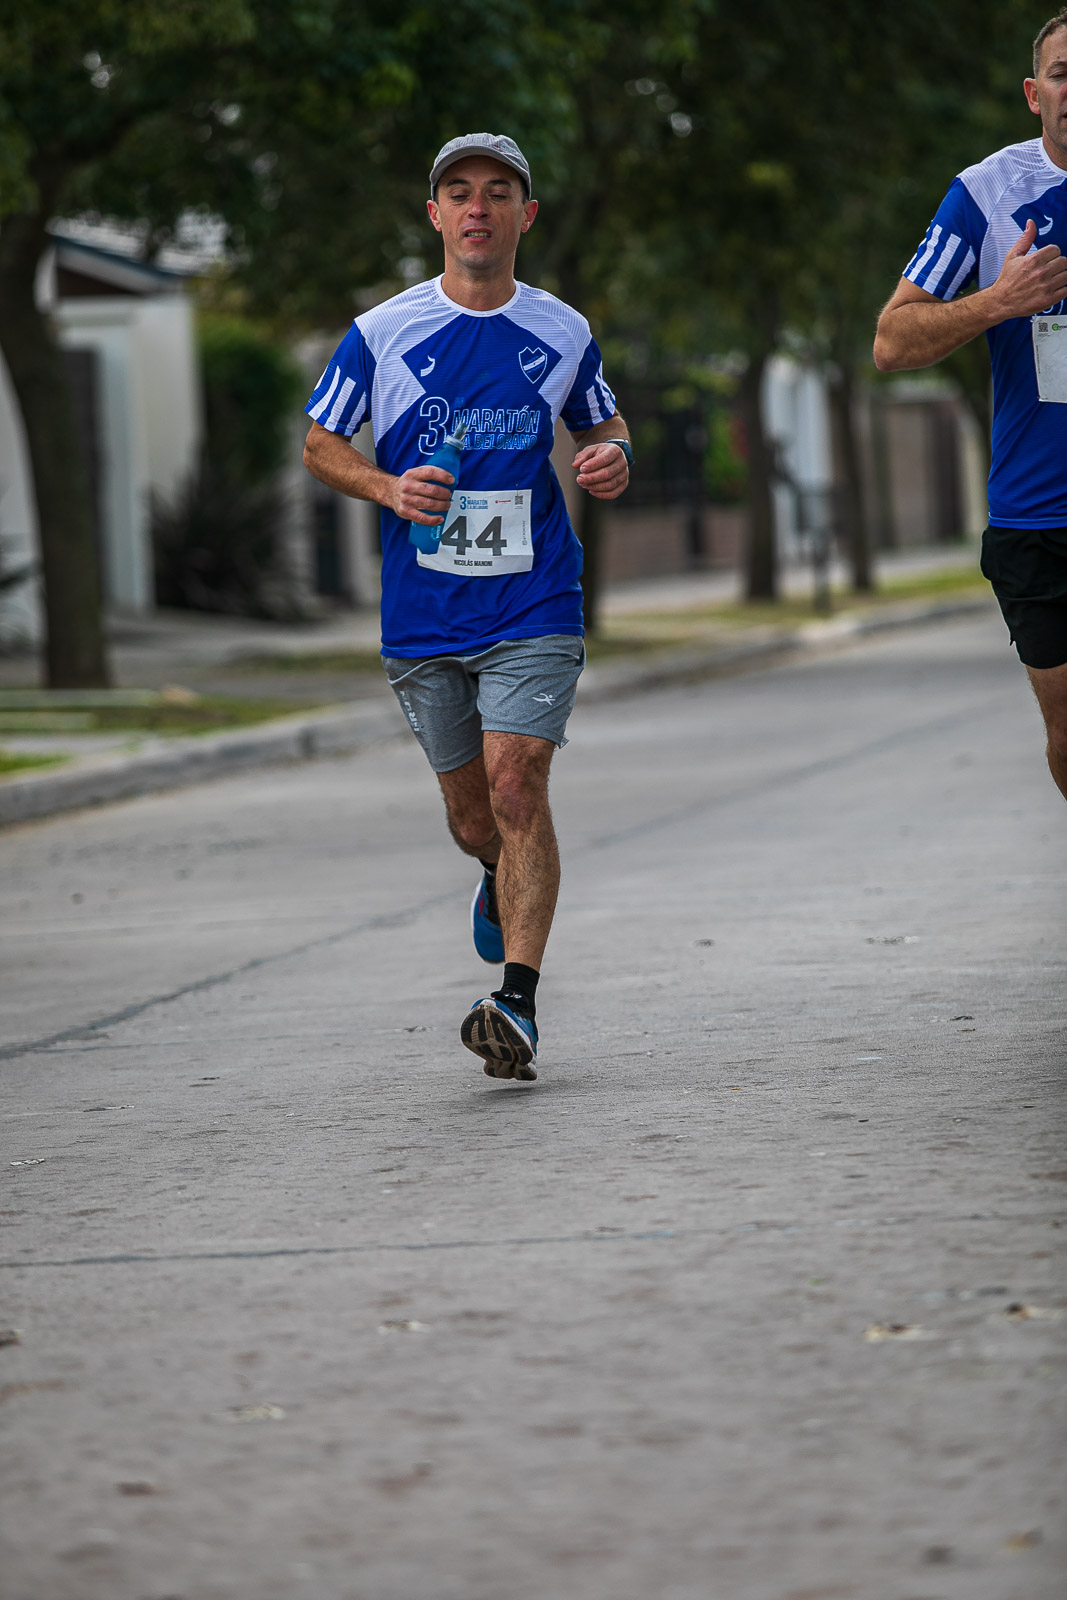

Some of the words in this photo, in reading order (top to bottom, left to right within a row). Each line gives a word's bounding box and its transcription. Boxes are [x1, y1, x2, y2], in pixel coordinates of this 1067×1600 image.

[418, 396, 450, 455] 3
[451, 405, 541, 434] MARATÓN
[460, 496, 467, 510] 3
[440, 515, 508, 557] 44
[453, 559, 473, 567] NICOLÁS
